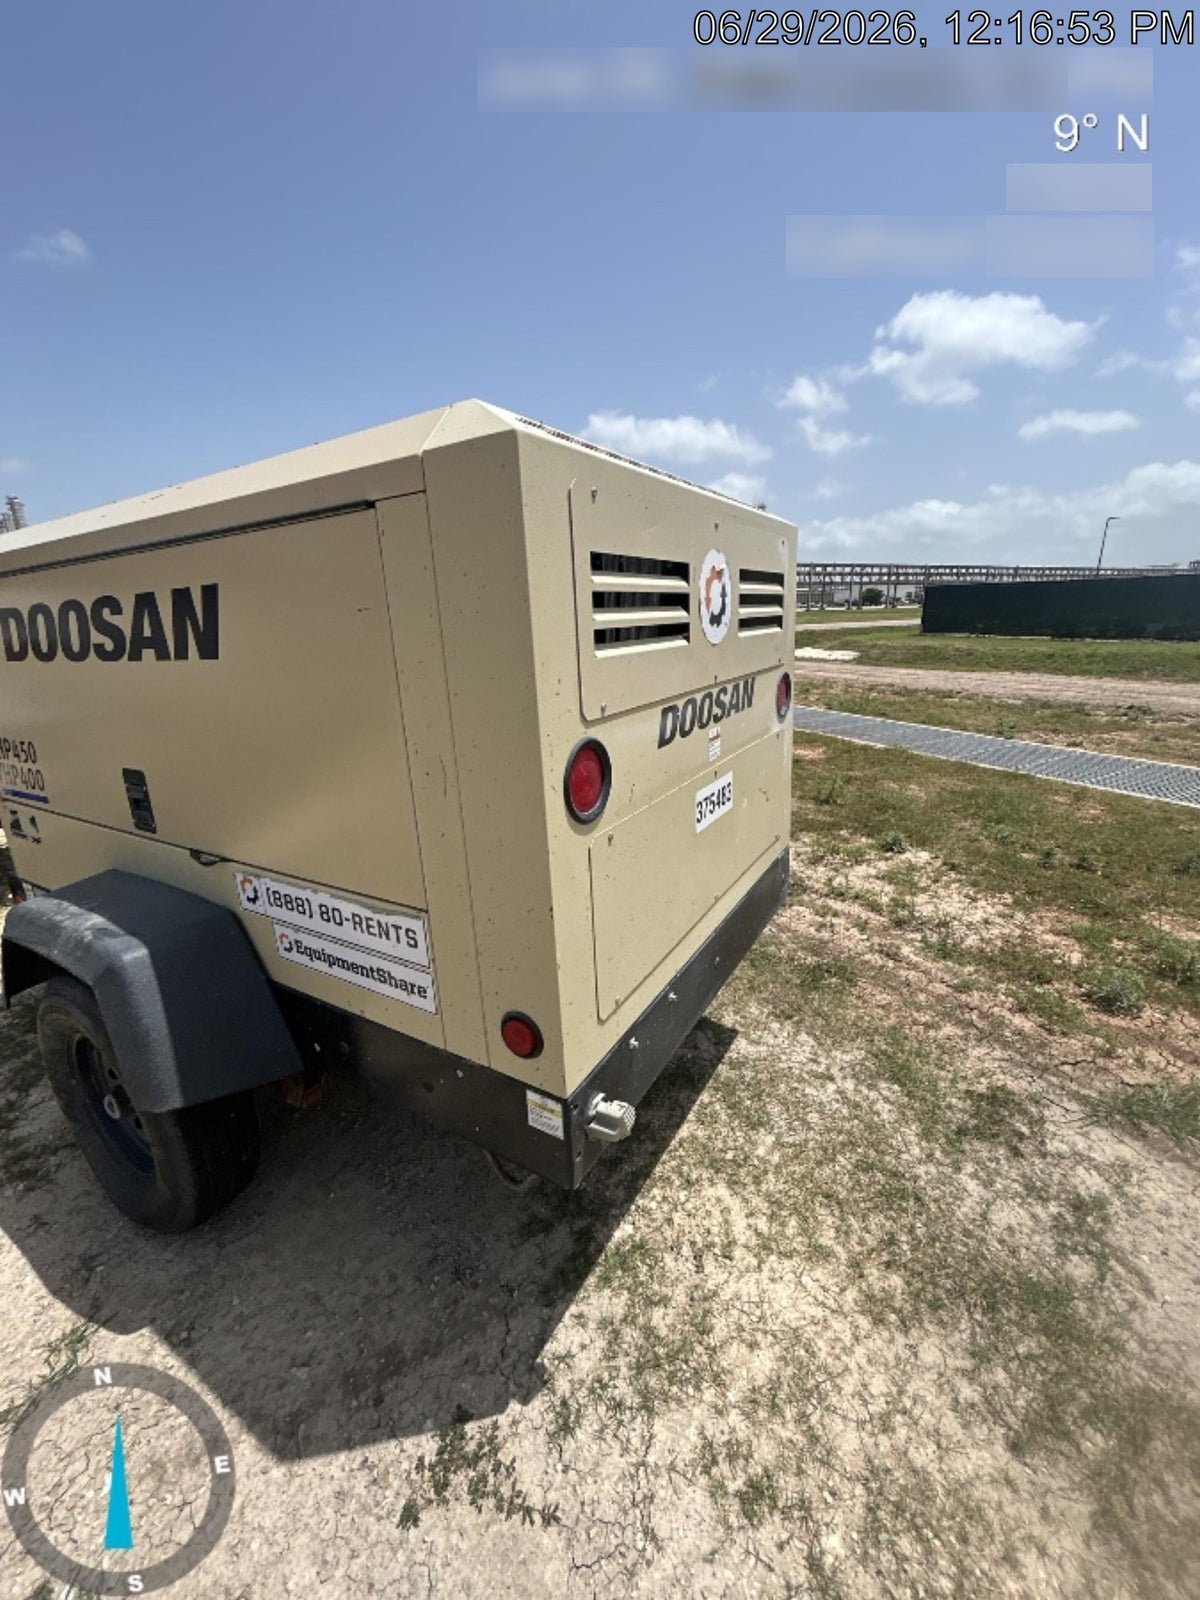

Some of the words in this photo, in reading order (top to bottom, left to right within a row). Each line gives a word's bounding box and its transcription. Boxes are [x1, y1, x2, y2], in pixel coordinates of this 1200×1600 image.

[0, 583, 219, 662] DOOSAN
[657, 677, 756, 750] DOOSAN
[265, 886, 314, 920] (888)
[318, 903, 419, 949] 80-RENTS
[294, 939, 428, 999] EquipmentShare
